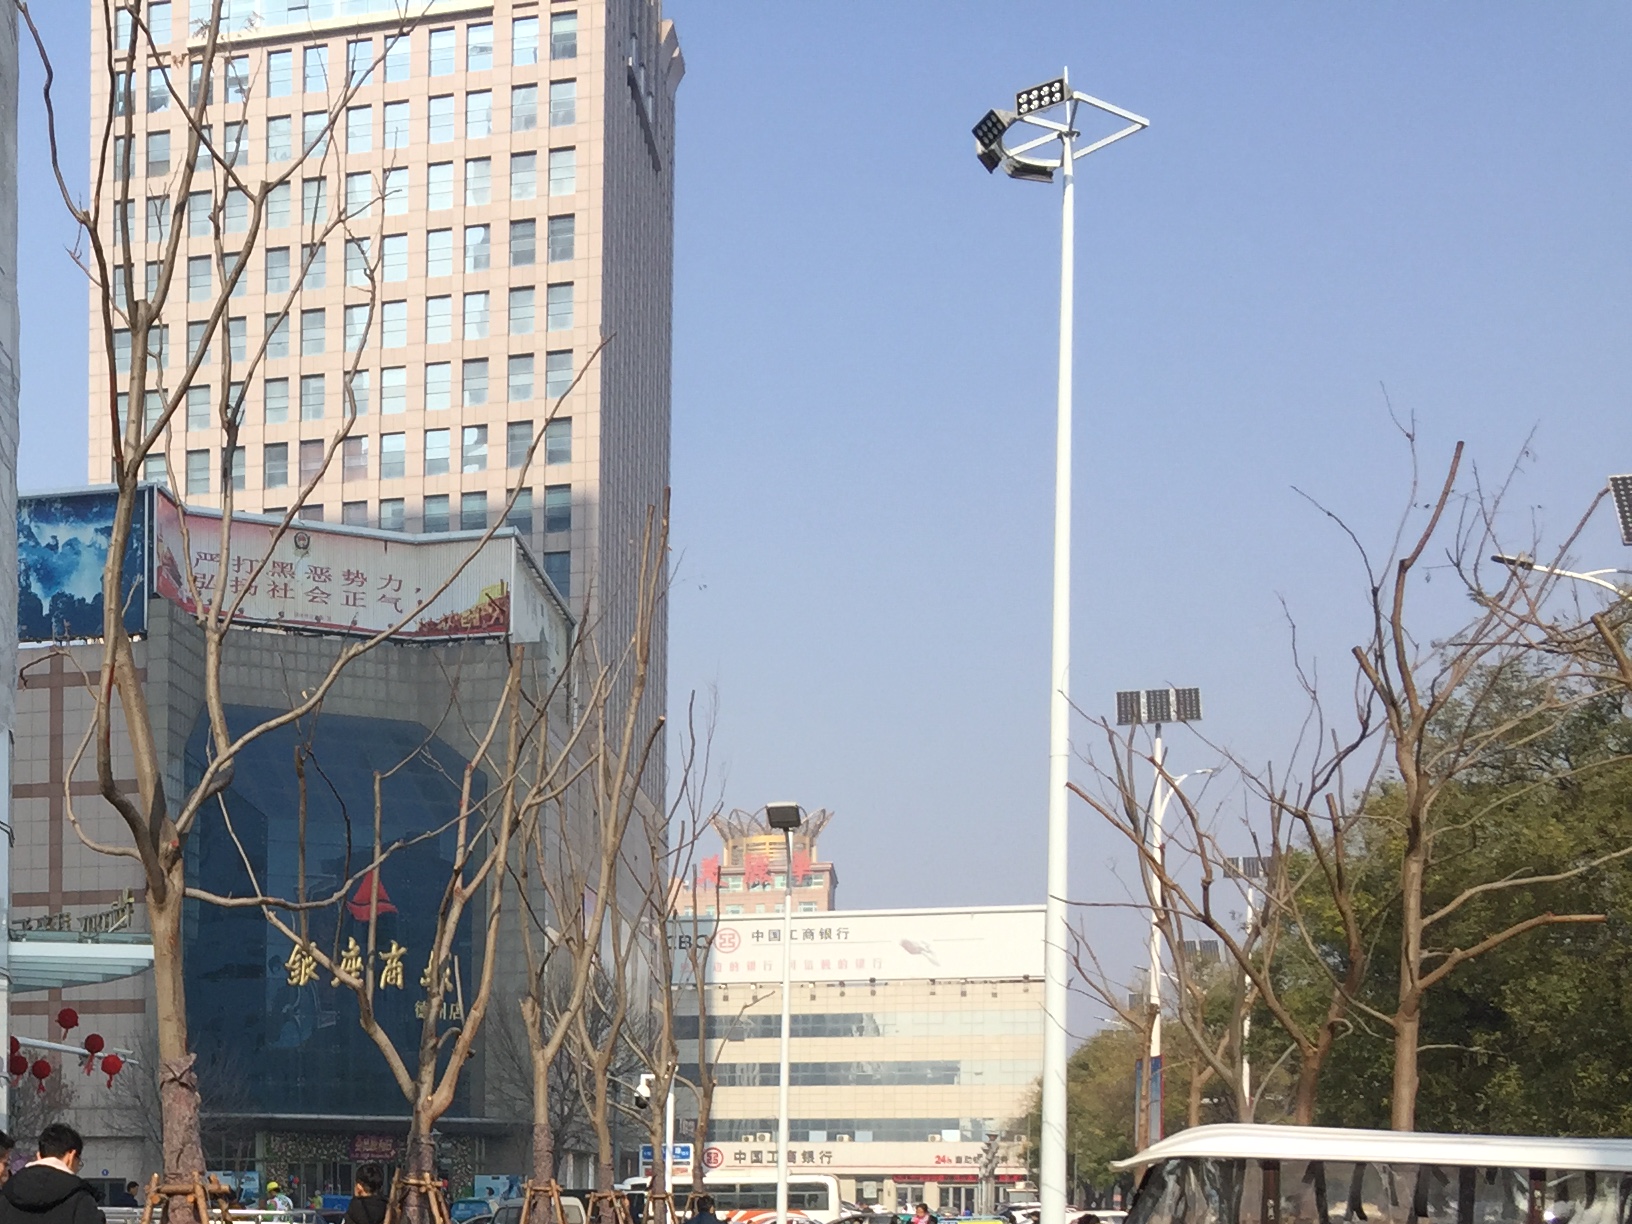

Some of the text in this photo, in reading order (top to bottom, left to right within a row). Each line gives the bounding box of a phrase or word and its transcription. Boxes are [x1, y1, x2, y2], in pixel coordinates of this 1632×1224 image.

[194, 572, 404, 614] 弘扬社会正气
[751, 926, 850, 943] 中国工商银行
